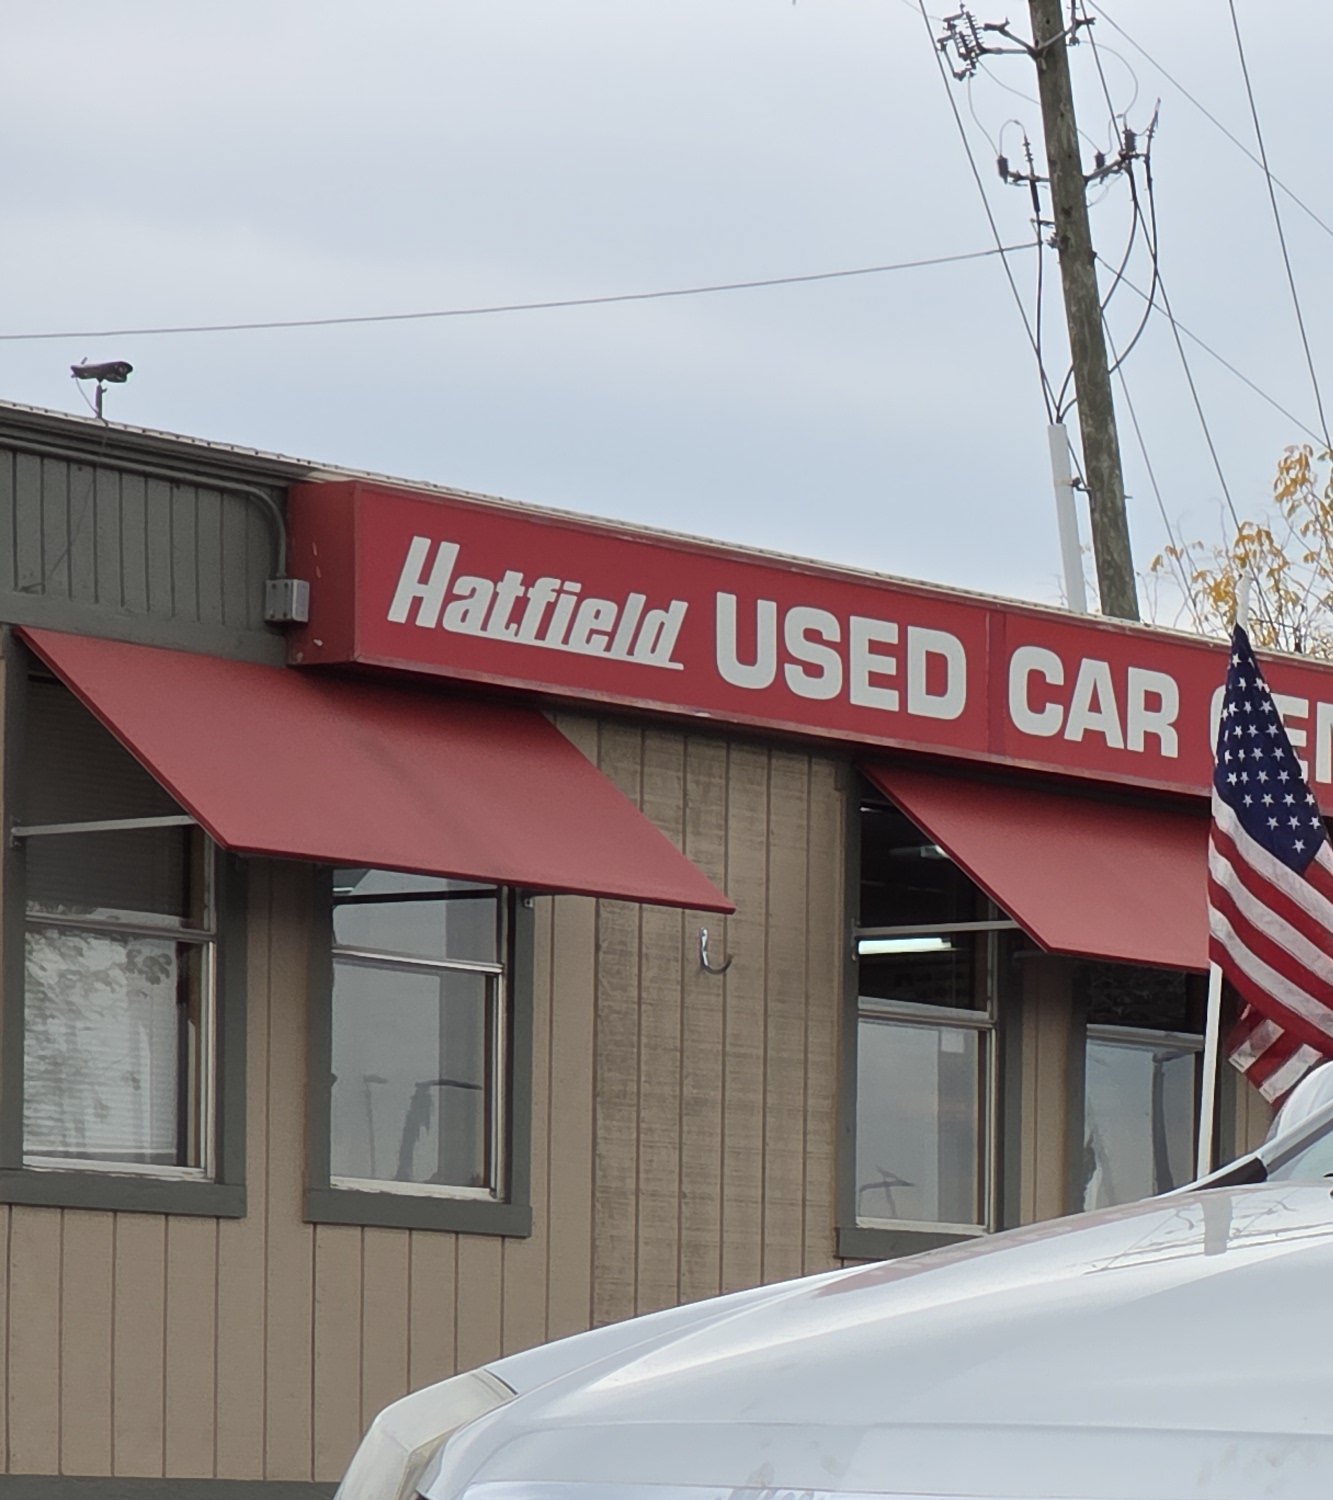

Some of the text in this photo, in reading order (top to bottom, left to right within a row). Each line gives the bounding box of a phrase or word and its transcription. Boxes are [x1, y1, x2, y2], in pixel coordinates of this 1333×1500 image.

[387, 535, 690, 671] Hatfield
[715, 591, 967, 720] USED
[1008, 646, 1180, 758] CAR
